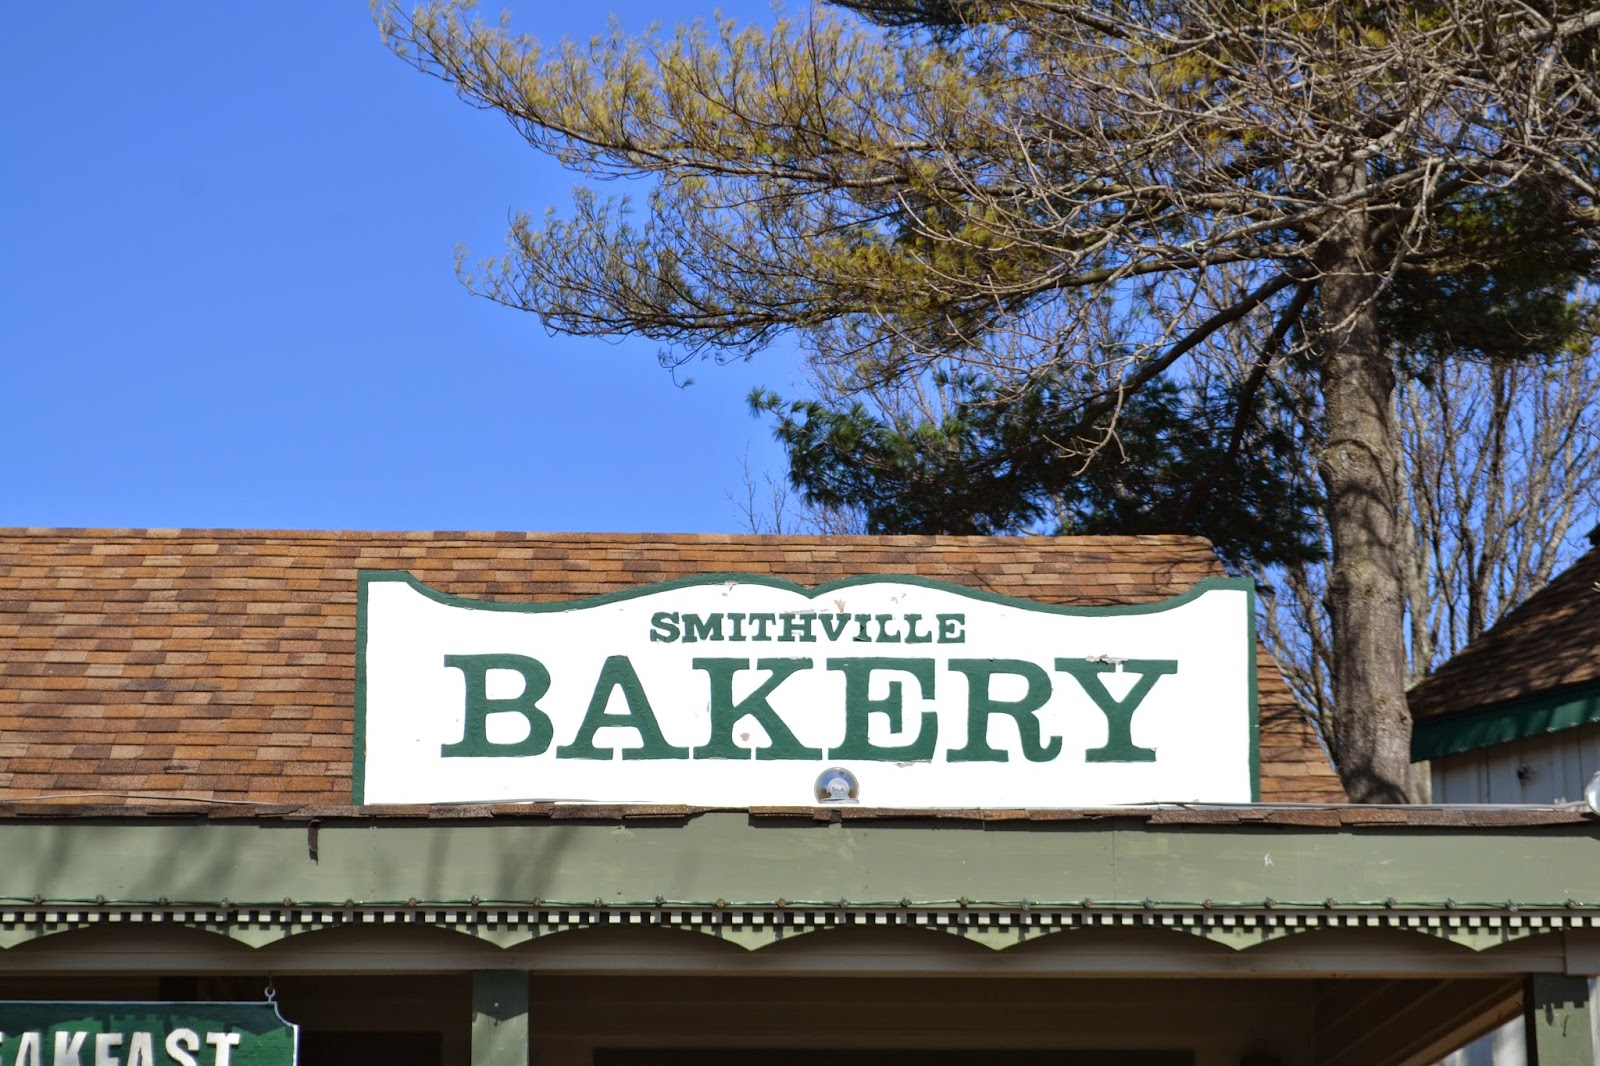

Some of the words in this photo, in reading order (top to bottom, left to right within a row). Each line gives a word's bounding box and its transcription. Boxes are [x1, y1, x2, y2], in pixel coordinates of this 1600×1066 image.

[651, 611, 965, 643] SMITHVILLE
[441, 654, 1178, 763] BAKERY
[0, 1027, 242, 1066] AKFAST
